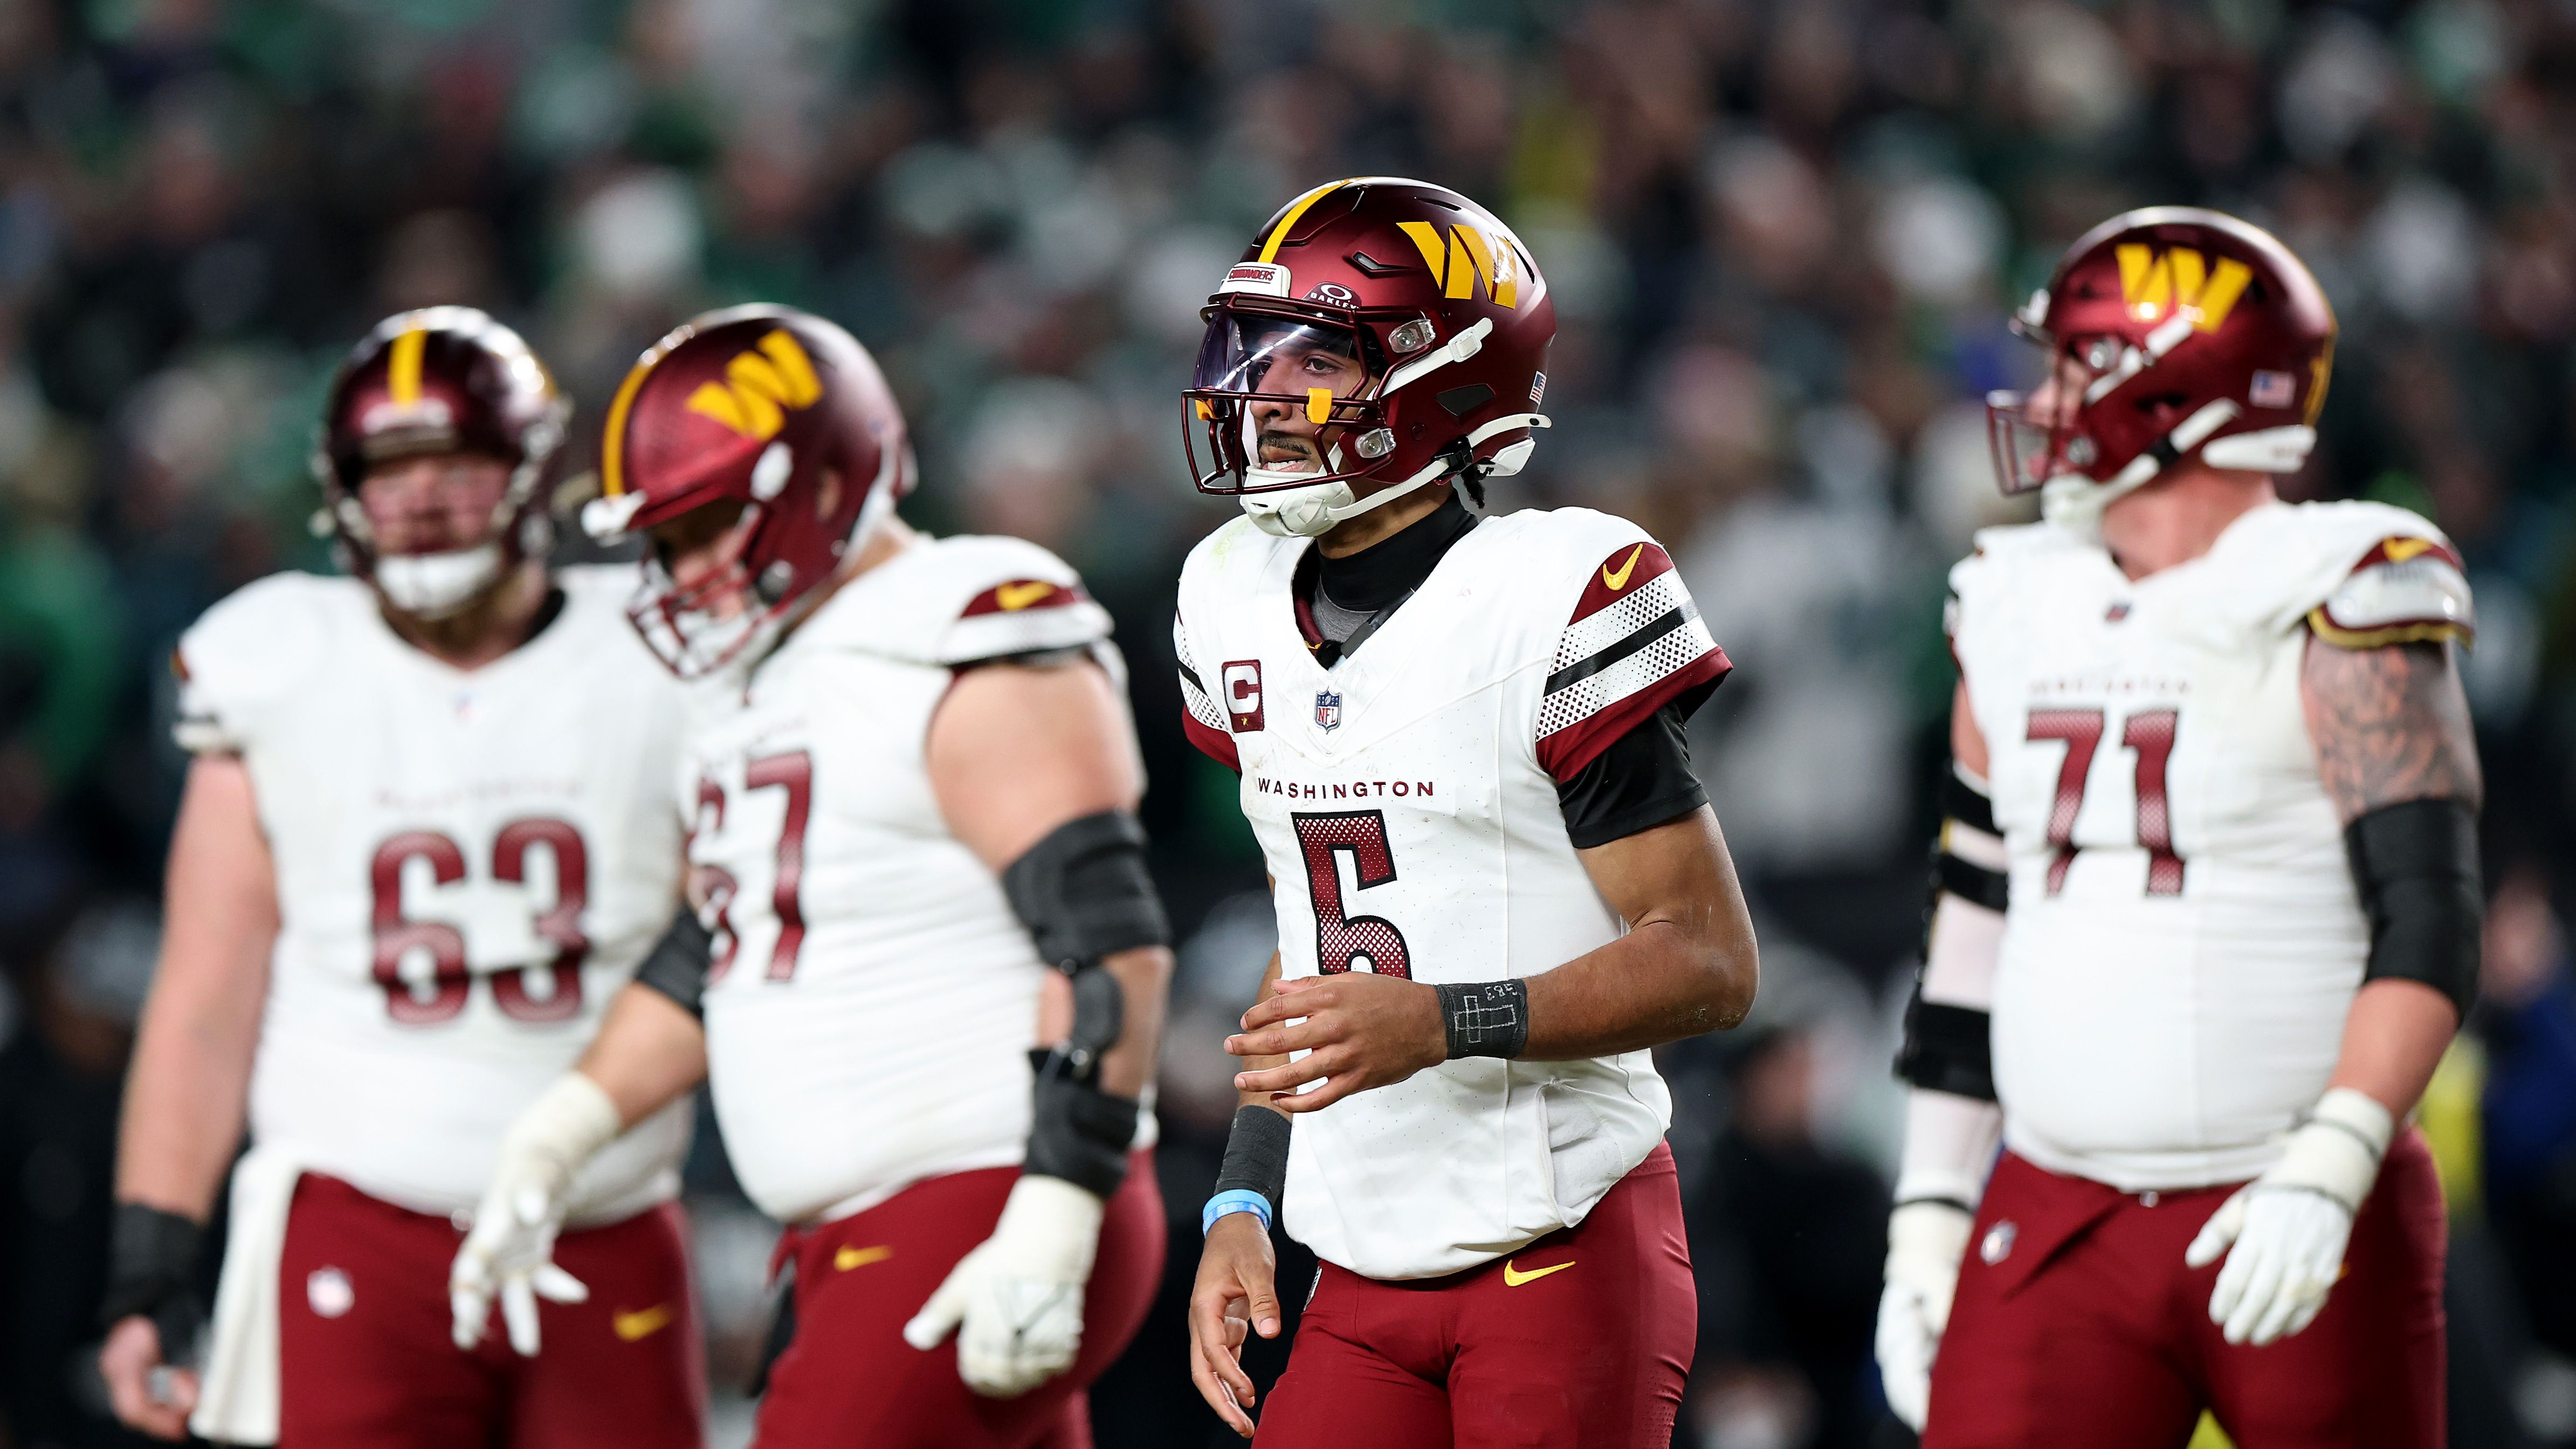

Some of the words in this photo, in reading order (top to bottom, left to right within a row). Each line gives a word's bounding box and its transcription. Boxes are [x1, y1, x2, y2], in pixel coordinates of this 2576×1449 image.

[1310, 292, 1357, 309] OAKLEY
[1224, 665, 1259, 714] C
[1318, 707, 1336, 724] NFL
[1258, 777, 1434, 799] WASHINGTON
[2026, 707, 2186, 898] 71
[369, 815, 590, 1027] 63
